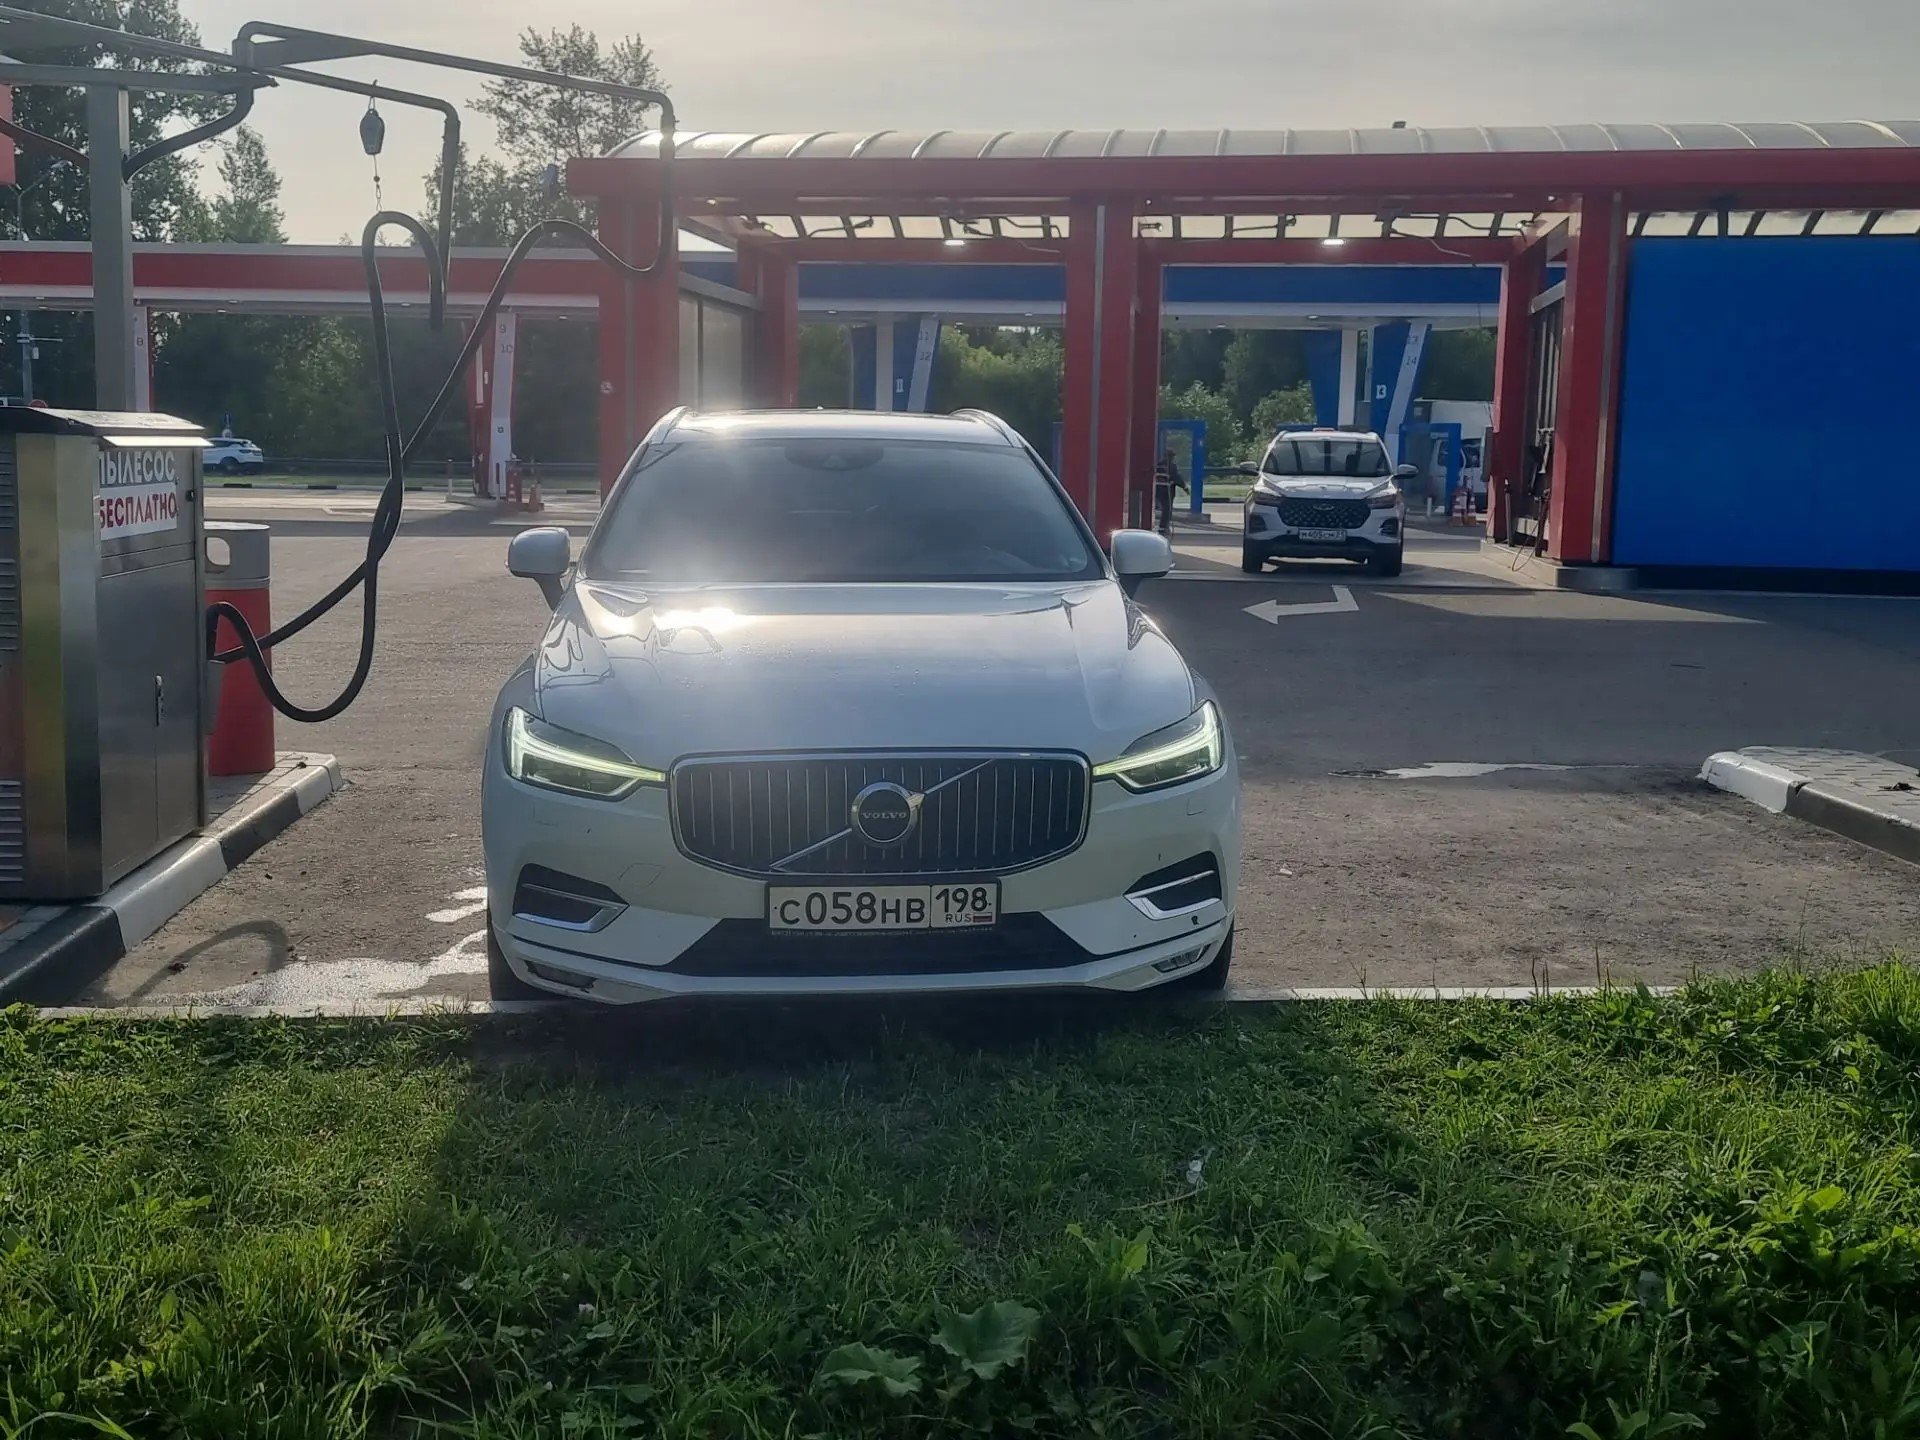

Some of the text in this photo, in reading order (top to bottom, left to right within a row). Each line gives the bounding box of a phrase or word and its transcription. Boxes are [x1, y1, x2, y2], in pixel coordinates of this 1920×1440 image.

[1375, 384, 1387, 399] 13
[99, 492, 177, 528] БЕСПЛАТНО
[862, 811, 906, 819] VOLVO
[780, 887, 988, 925] С058НВ 198
[945, 913, 972, 923] RUS
